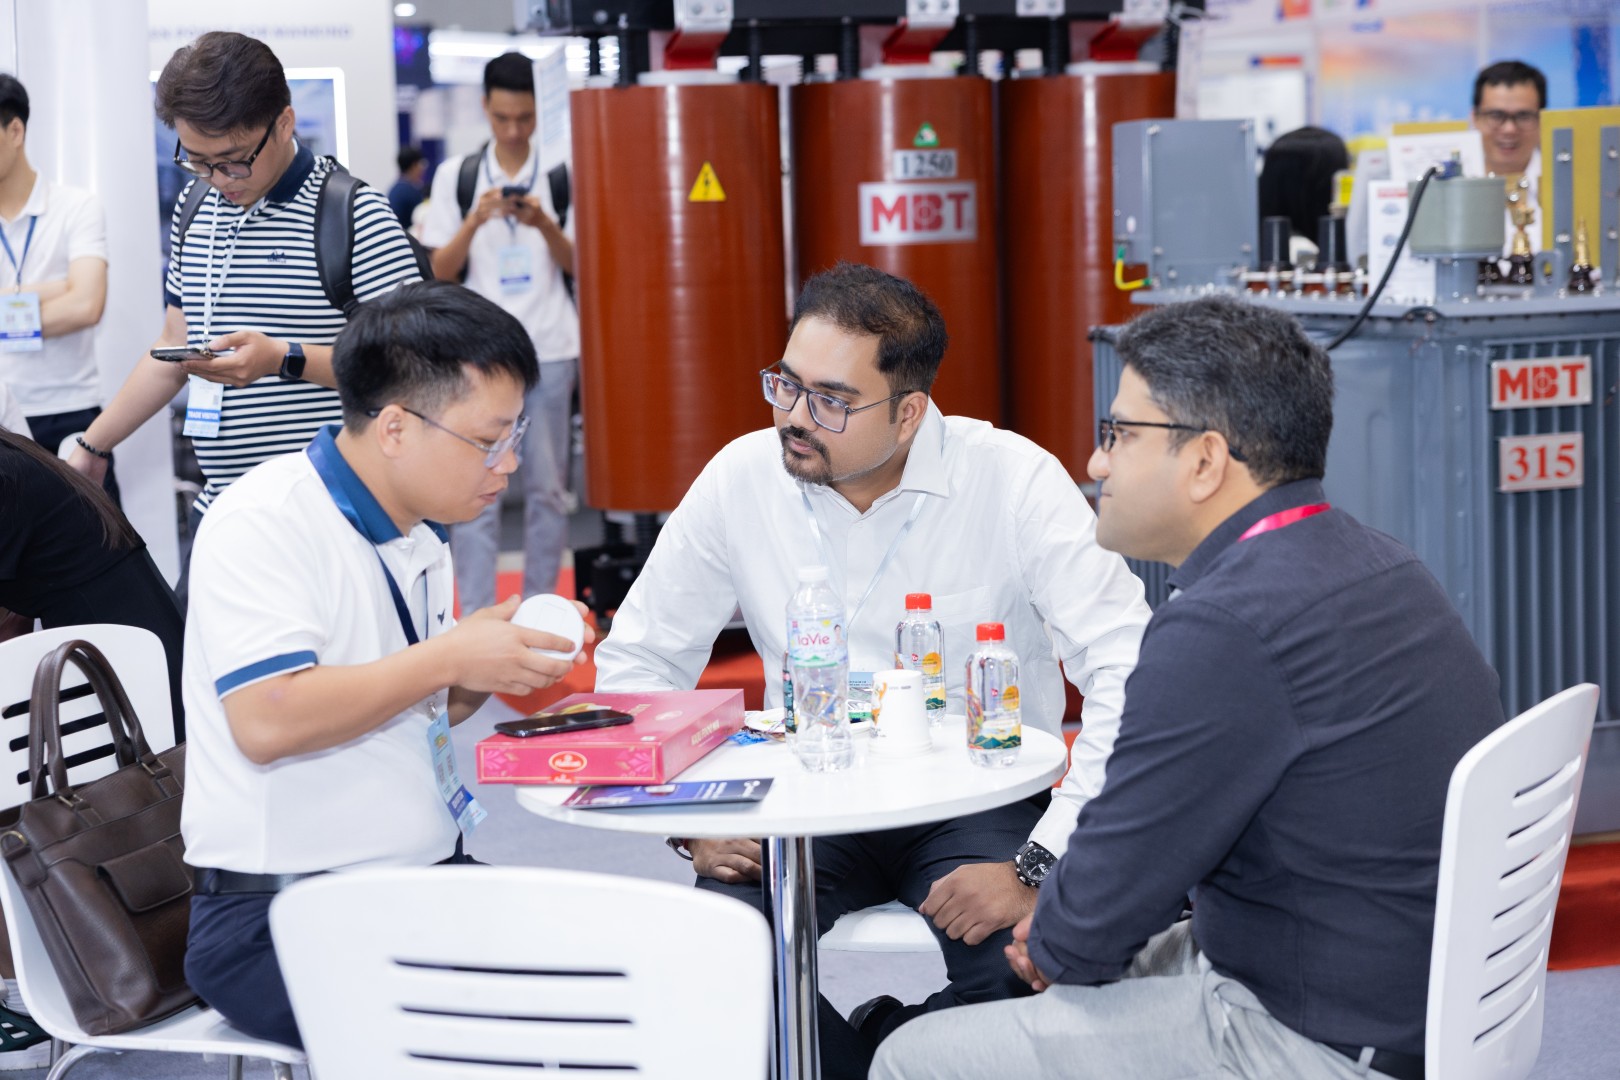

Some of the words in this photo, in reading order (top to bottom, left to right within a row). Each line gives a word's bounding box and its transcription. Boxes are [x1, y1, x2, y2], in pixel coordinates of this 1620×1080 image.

[902, 153, 954, 176] 1250
[871, 192, 969, 233] MBT
[1498, 364, 1585, 402] MBT
[1508, 443, 1576, 482] 315
[797, 632, 830, 646] laVie
